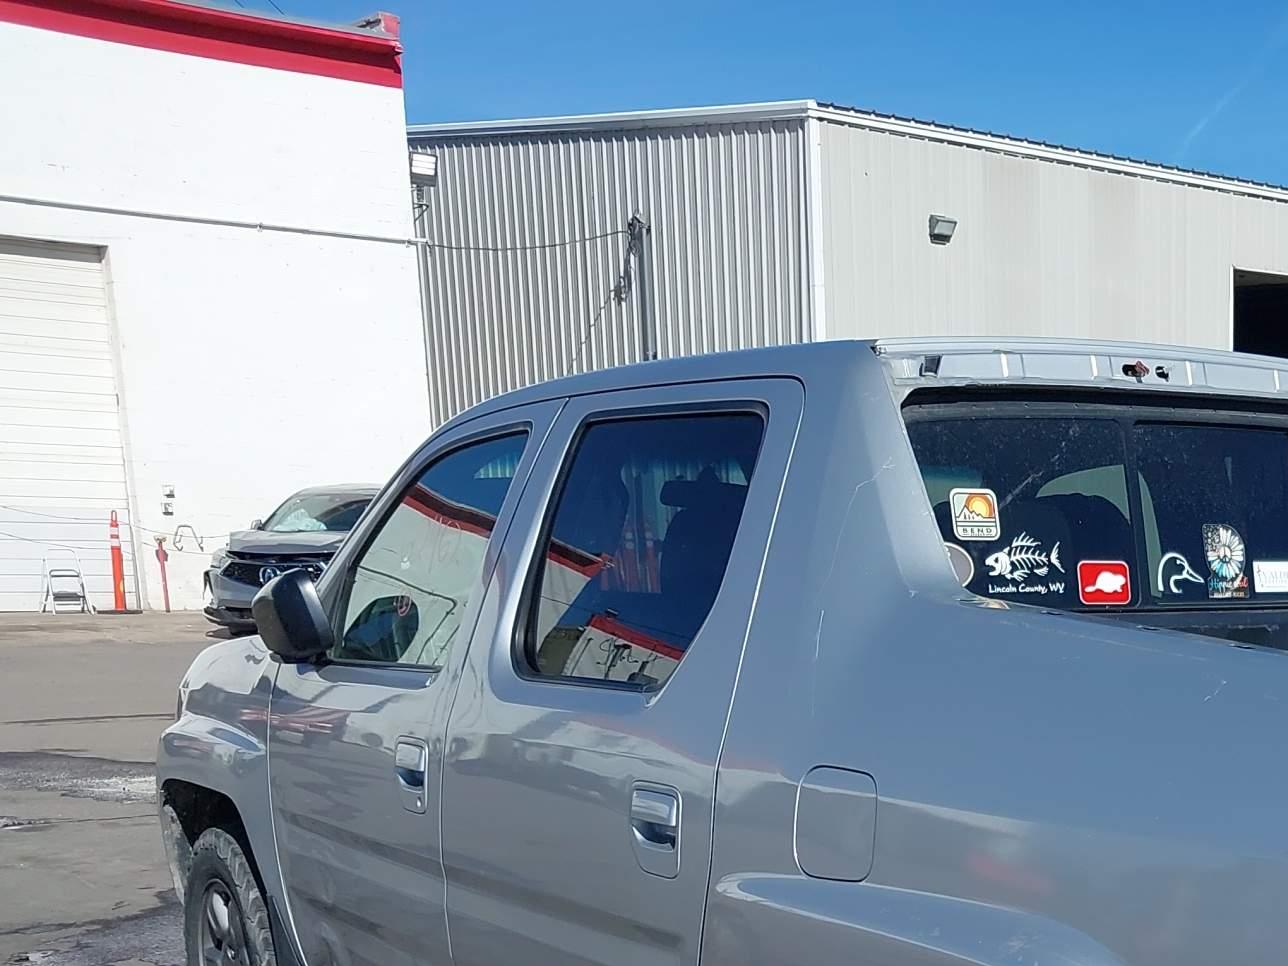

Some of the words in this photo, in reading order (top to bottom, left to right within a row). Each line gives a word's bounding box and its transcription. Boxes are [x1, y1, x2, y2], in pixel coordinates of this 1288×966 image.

[988, 583, 1017, 593] Lincoln
[1018, 583, 1048, 594] County,
[1049, 582, 1065, 593] WY
